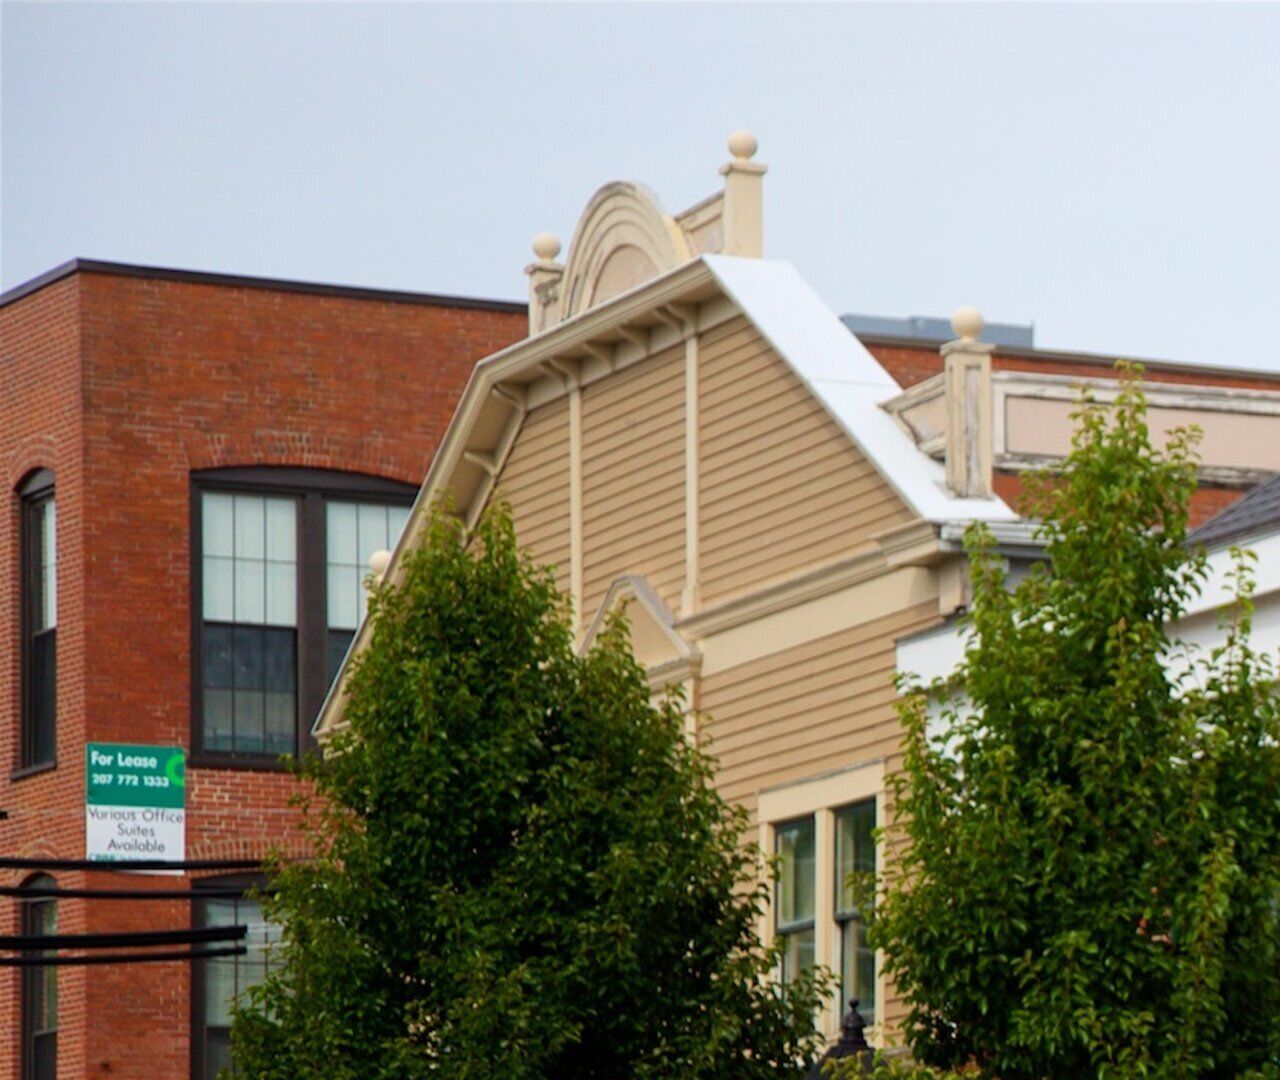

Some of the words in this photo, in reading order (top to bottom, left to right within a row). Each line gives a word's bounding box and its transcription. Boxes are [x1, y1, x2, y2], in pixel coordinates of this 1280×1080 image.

[91, 750, 114, 766] For
[117, 752, 158, 769] Lease
[88, 807, 137, 821] Various
[142, 809, 184, 823] Office
[117, 823, 155, 837] Suites
[107, 839, 166, 852] Available
